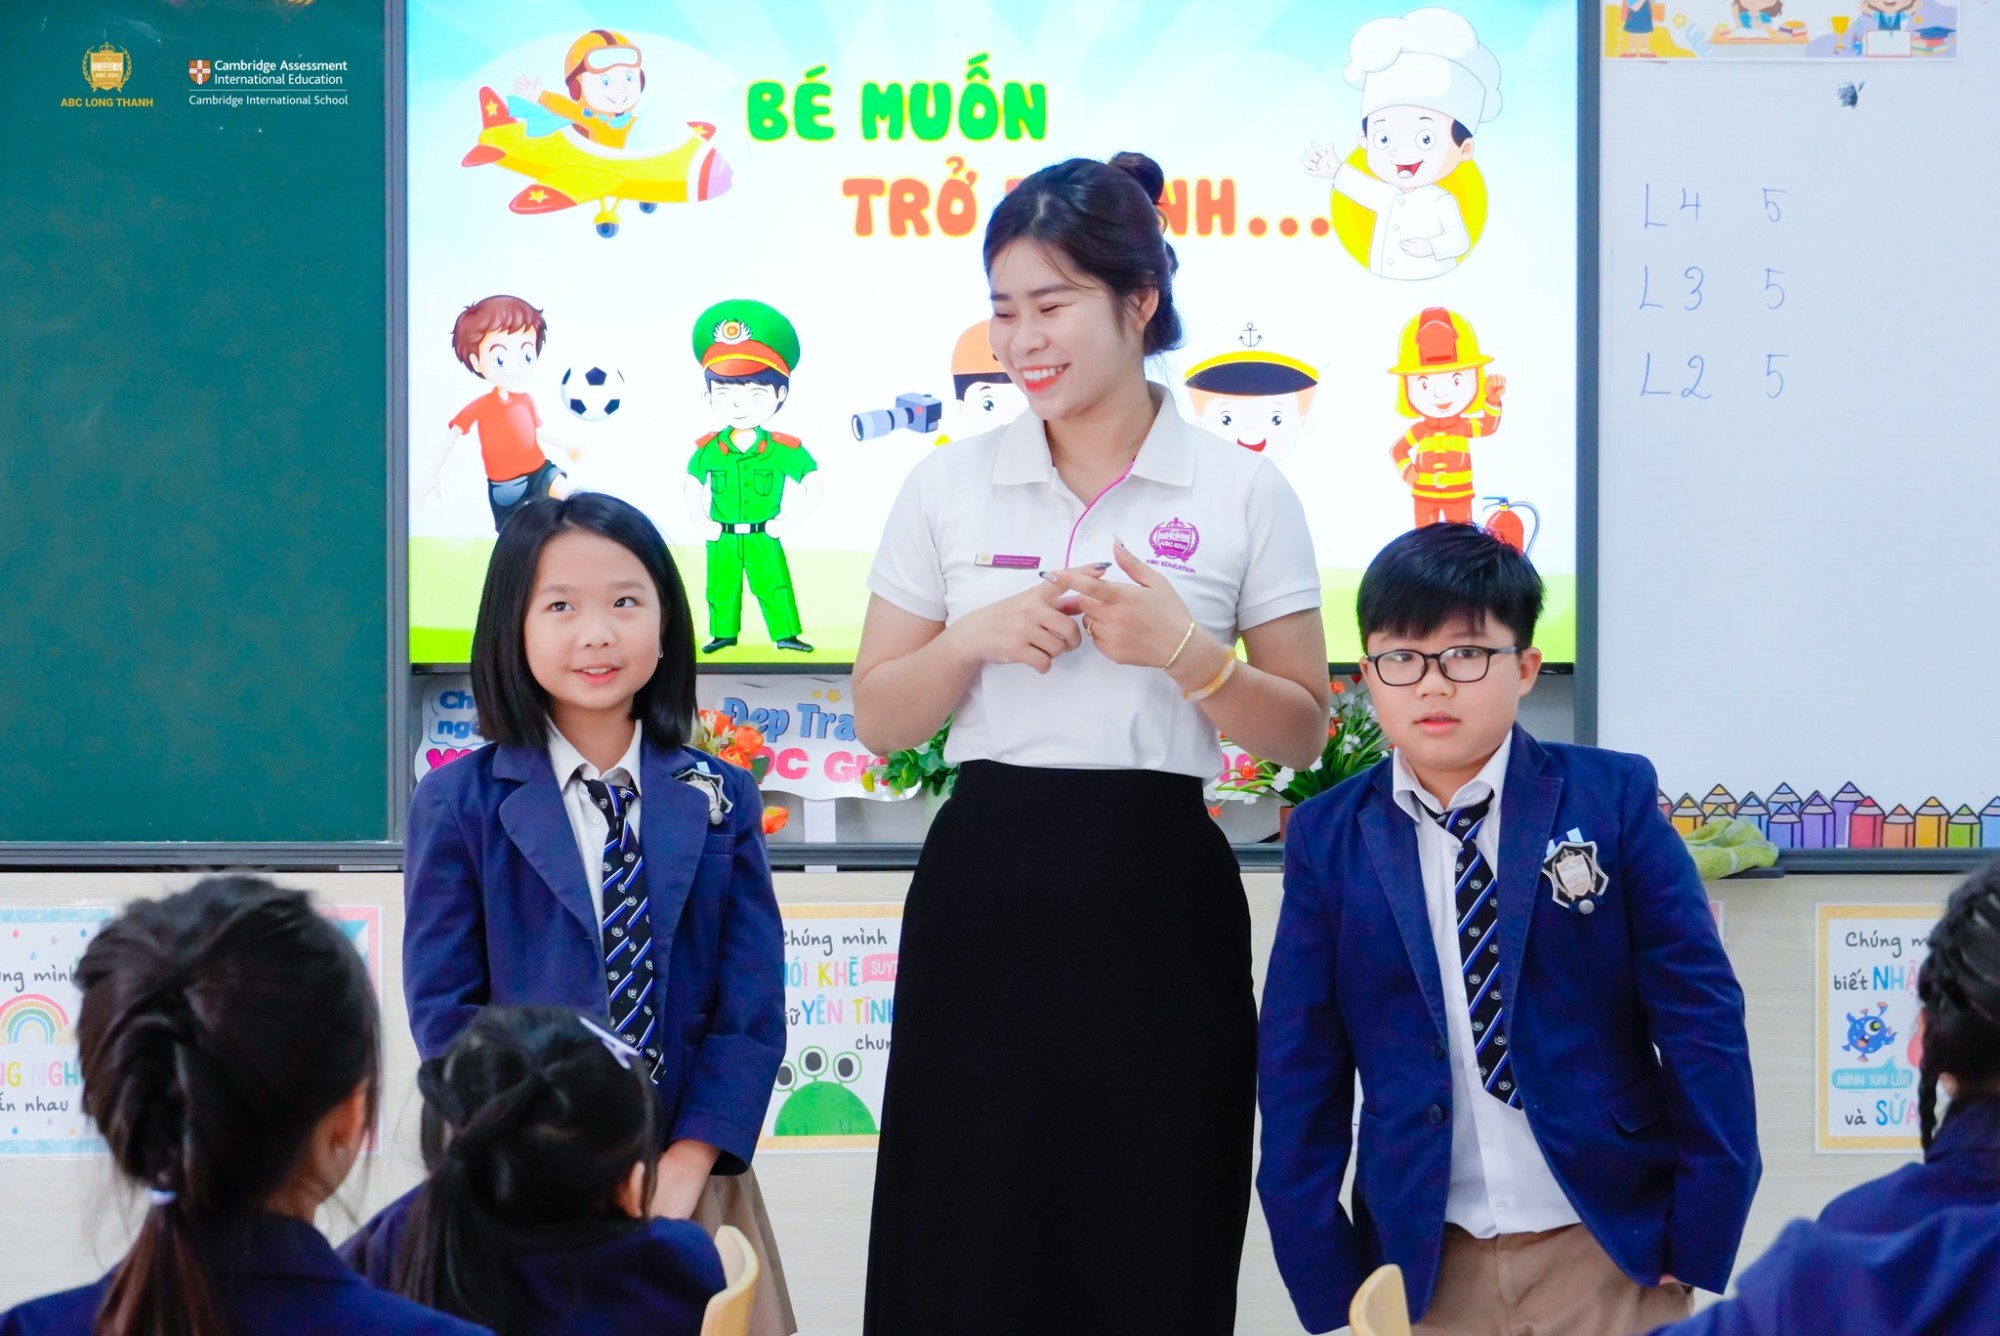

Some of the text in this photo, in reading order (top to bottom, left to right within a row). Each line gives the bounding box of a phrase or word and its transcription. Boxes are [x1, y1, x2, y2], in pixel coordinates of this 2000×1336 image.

[746, 53, 1047, 142] BÉ MUỐN
[842, 156, 979, 238] TRỞ
[1762, 188, 1788, 223] 5
[1764, 268, 1785, 310] 5
[1765, 353, 1790, 399] 5
[1161, 561, 1196, 574] EDUCATION
[440, 690, 476, 709] Ch
[797, 703, 856, 742] Tra
[842, 928, 888, 945] mình
[1845, 930, 1902, 958] Chúng
[0, 965, 77, 993] ng mình
[818, 956, 859, 988] KHẼ
[1833, 959, 1919, 997] biết NHẬ
[801, 994, 843, 1026] YÊN
[855, 1034, 892, 1051] chu
[25, 1096, 69, 1112] nhau
[1845, 1093, 1921, 1126] và SỬA
